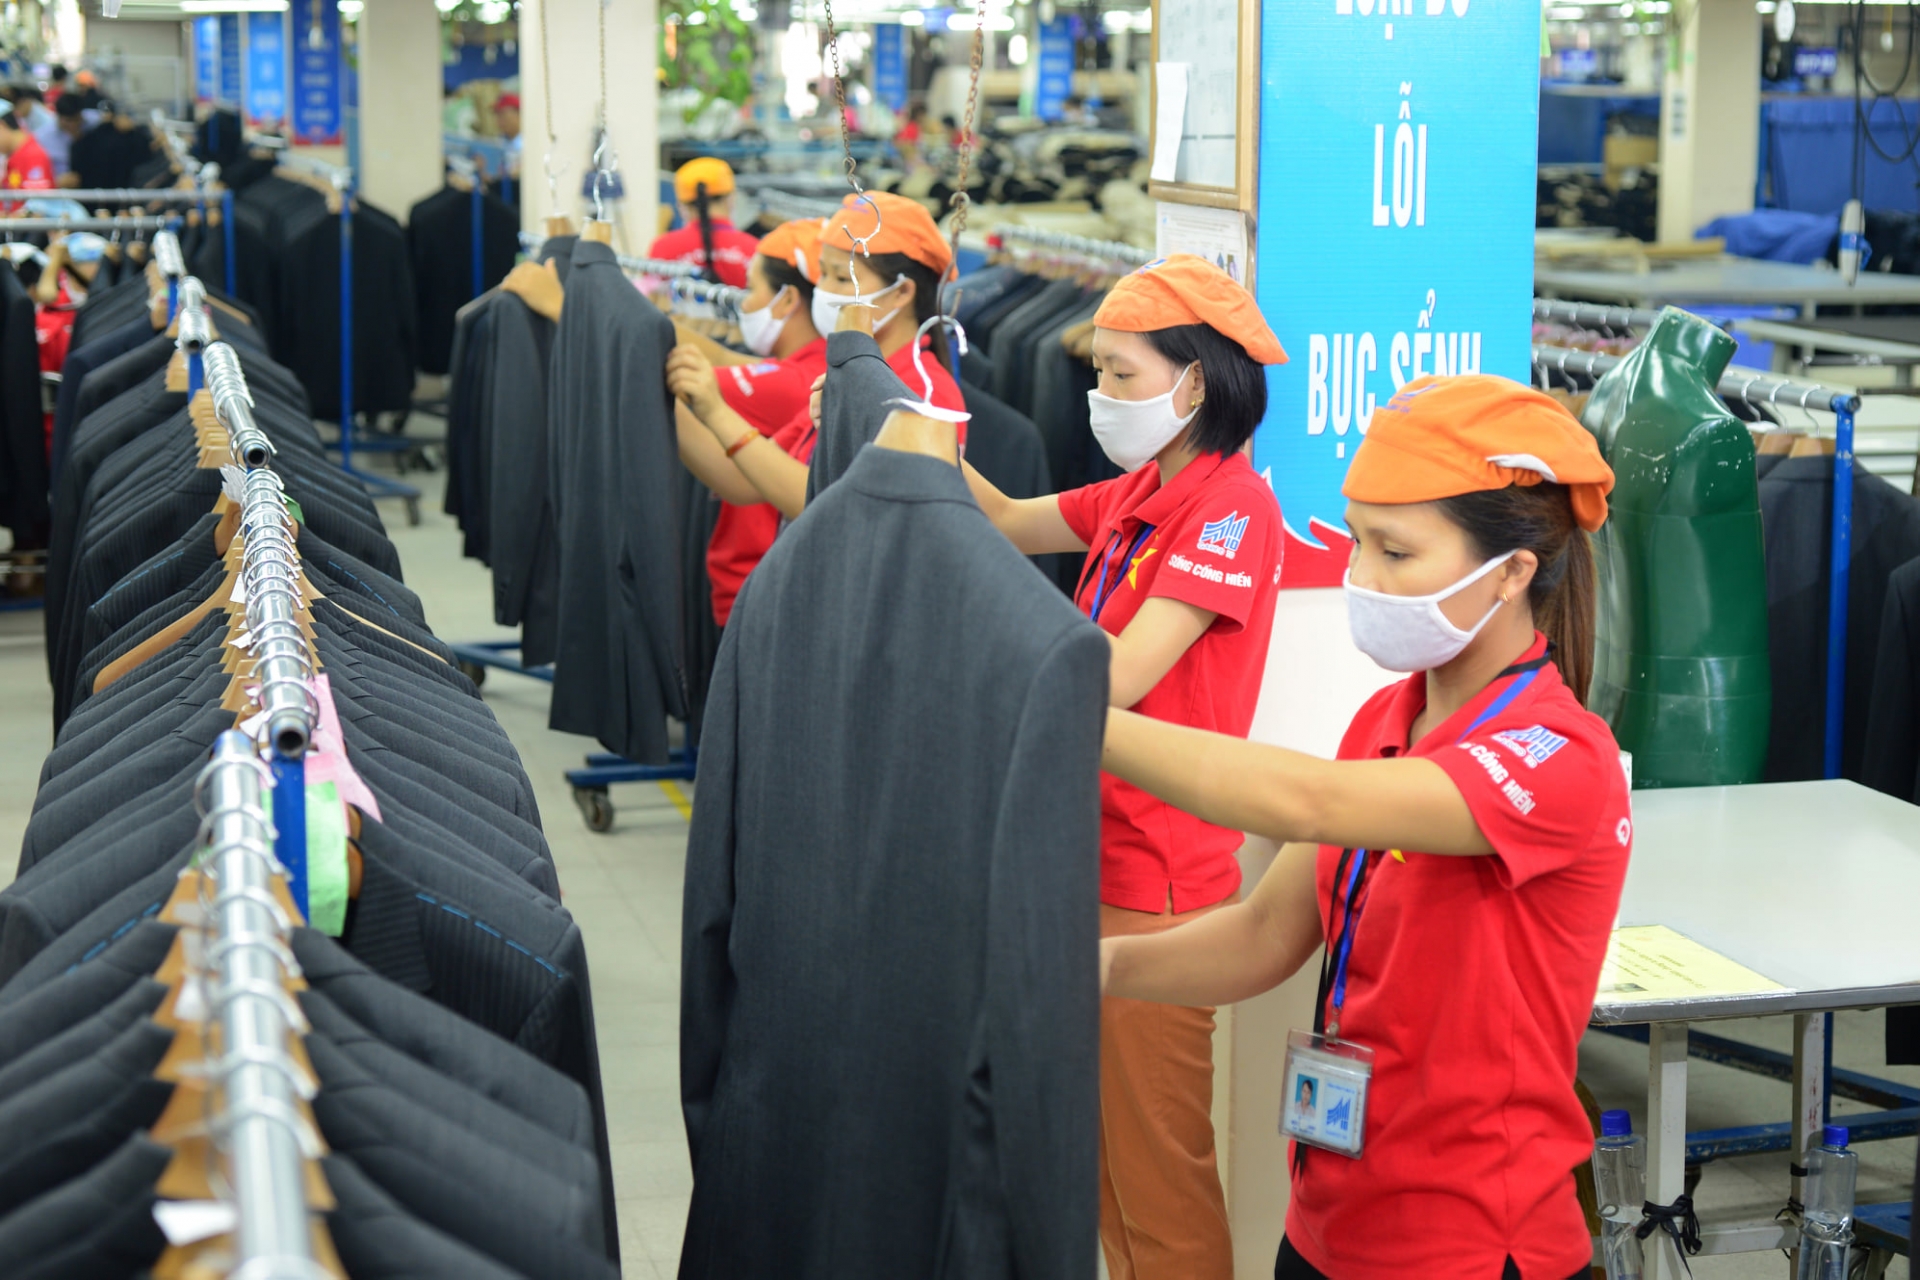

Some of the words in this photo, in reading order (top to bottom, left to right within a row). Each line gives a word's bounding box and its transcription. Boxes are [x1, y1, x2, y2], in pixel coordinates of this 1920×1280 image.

[1373, 81, 1427, 227] LỖI
[1307, 332, 1377, 458] BỤC
[1168, 554, 1194, 573] SỐNG
[1192, 563, 1224, 583] CỐNG
[1225, 571, 1252, 588] HIẾN
[1470, 745, 1509, 785] CỐNG
[1502, 779, 1536, 816] HIẾN
